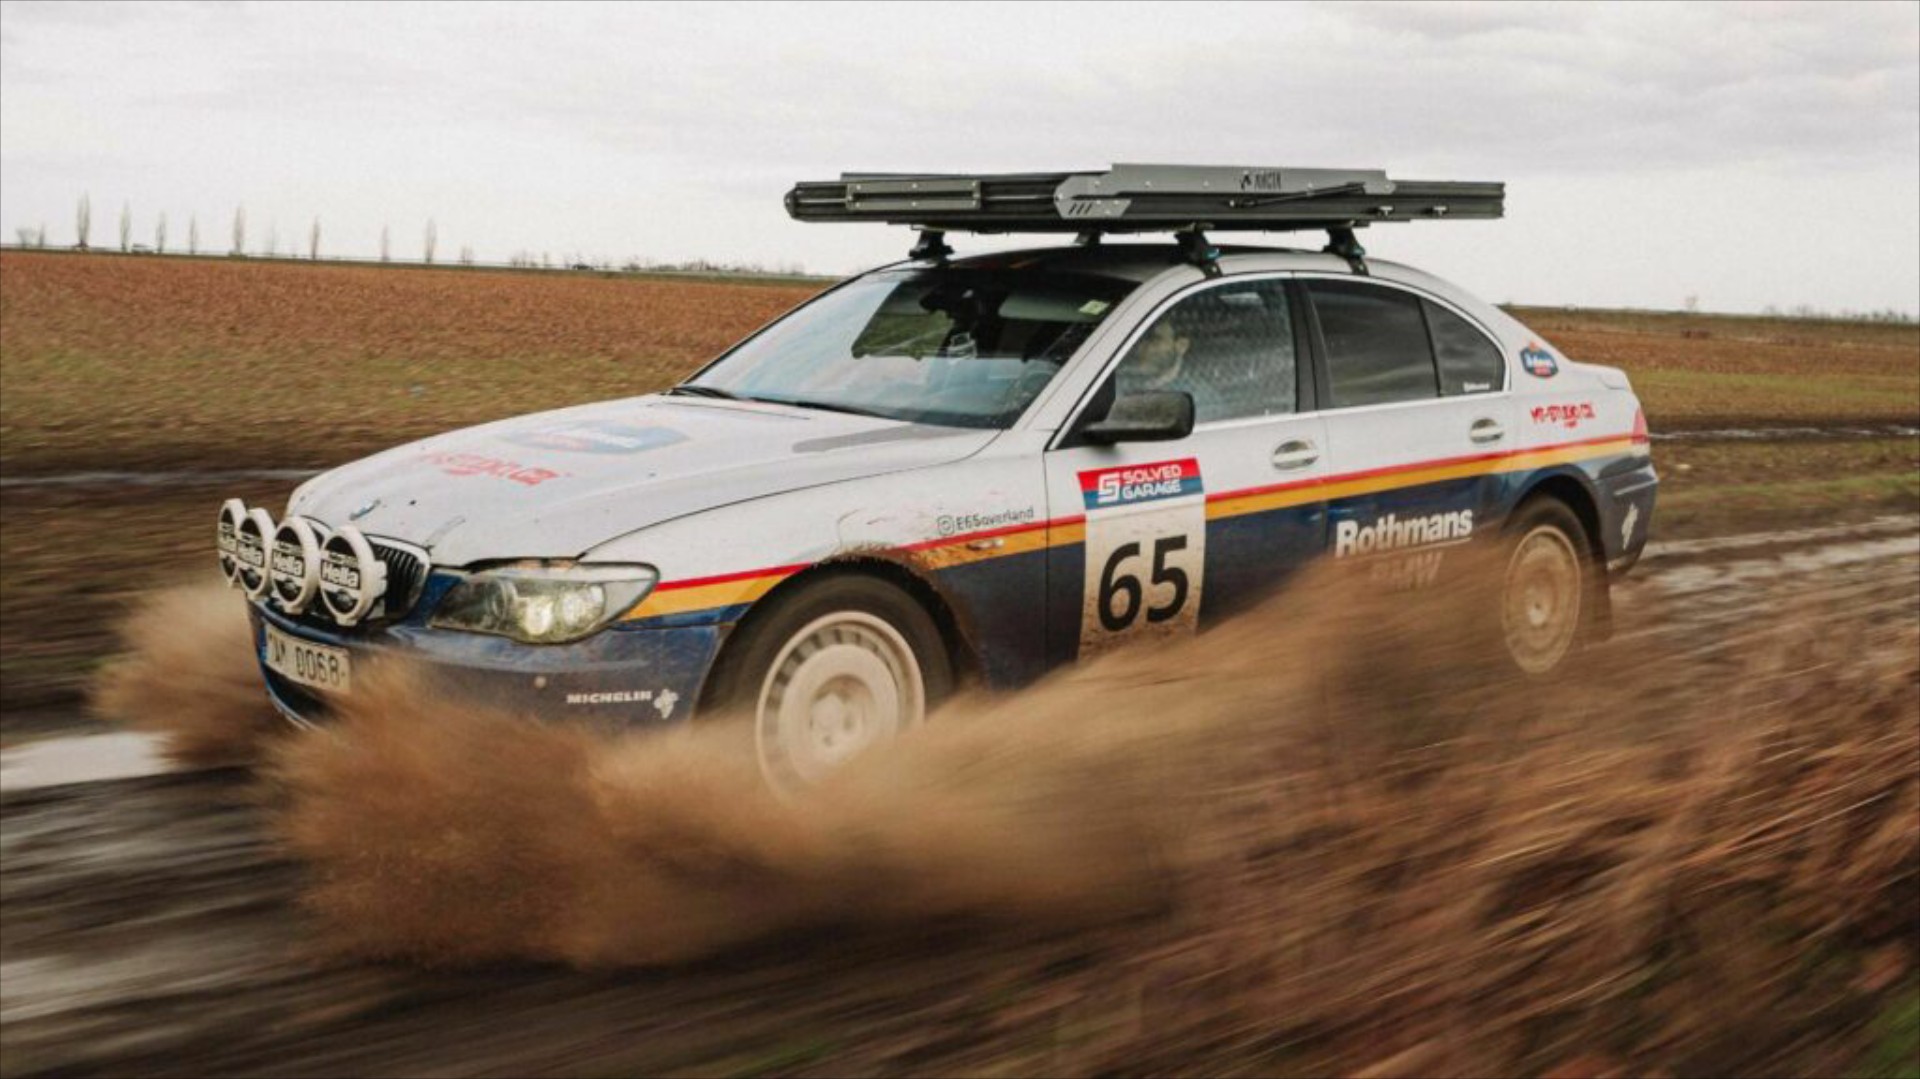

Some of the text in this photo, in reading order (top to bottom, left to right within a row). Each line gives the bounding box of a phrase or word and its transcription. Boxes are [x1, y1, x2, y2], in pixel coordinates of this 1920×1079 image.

[1122, 464, 1182, 484] SOLVED
[1122, 479, 1182, 499] GARAGE
[1335, 509, 1473, 558] Rothmans
[273, 551, 304, 576] Hella
[323, 562, 359, 587] Hella
[1099, 535, 1189, 632] 65
[566, 690, 653, 704] MICHELIN
